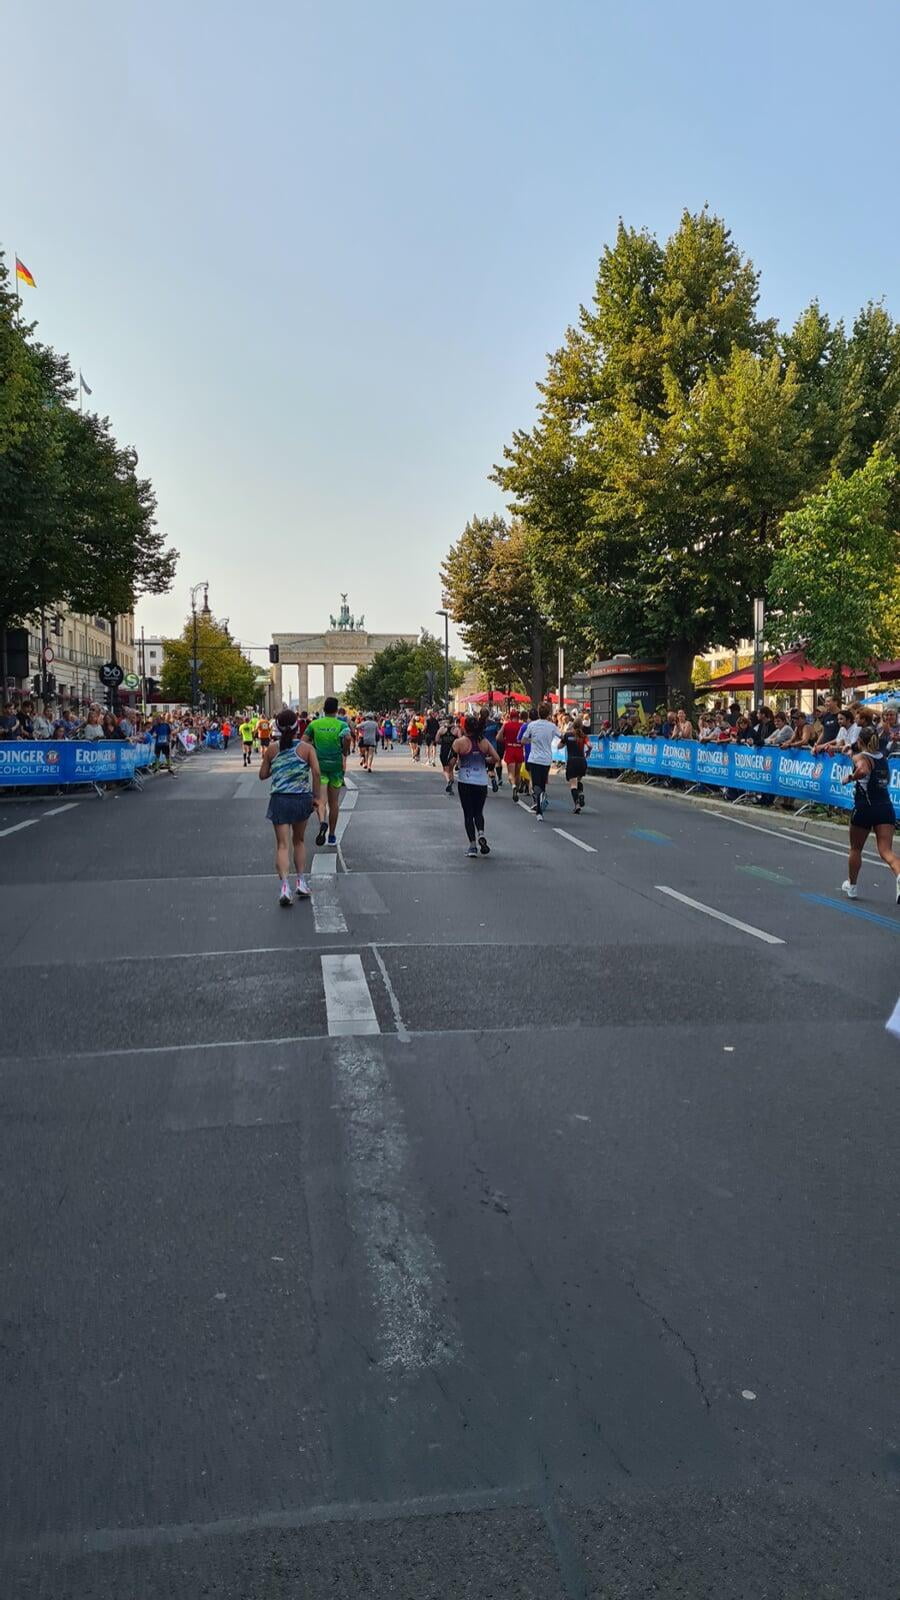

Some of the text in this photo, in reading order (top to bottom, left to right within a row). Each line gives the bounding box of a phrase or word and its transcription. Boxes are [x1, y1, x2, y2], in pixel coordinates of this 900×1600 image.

[127, 674, 137, 686] S
[734, 752, 764, 771] ERDINGER
[779, 756, 815, 779] ERDINGER
[735, 770, 772, 782] ALKOHOLFREI
[778, 775, 821, 791] ALKOHOLFREI
